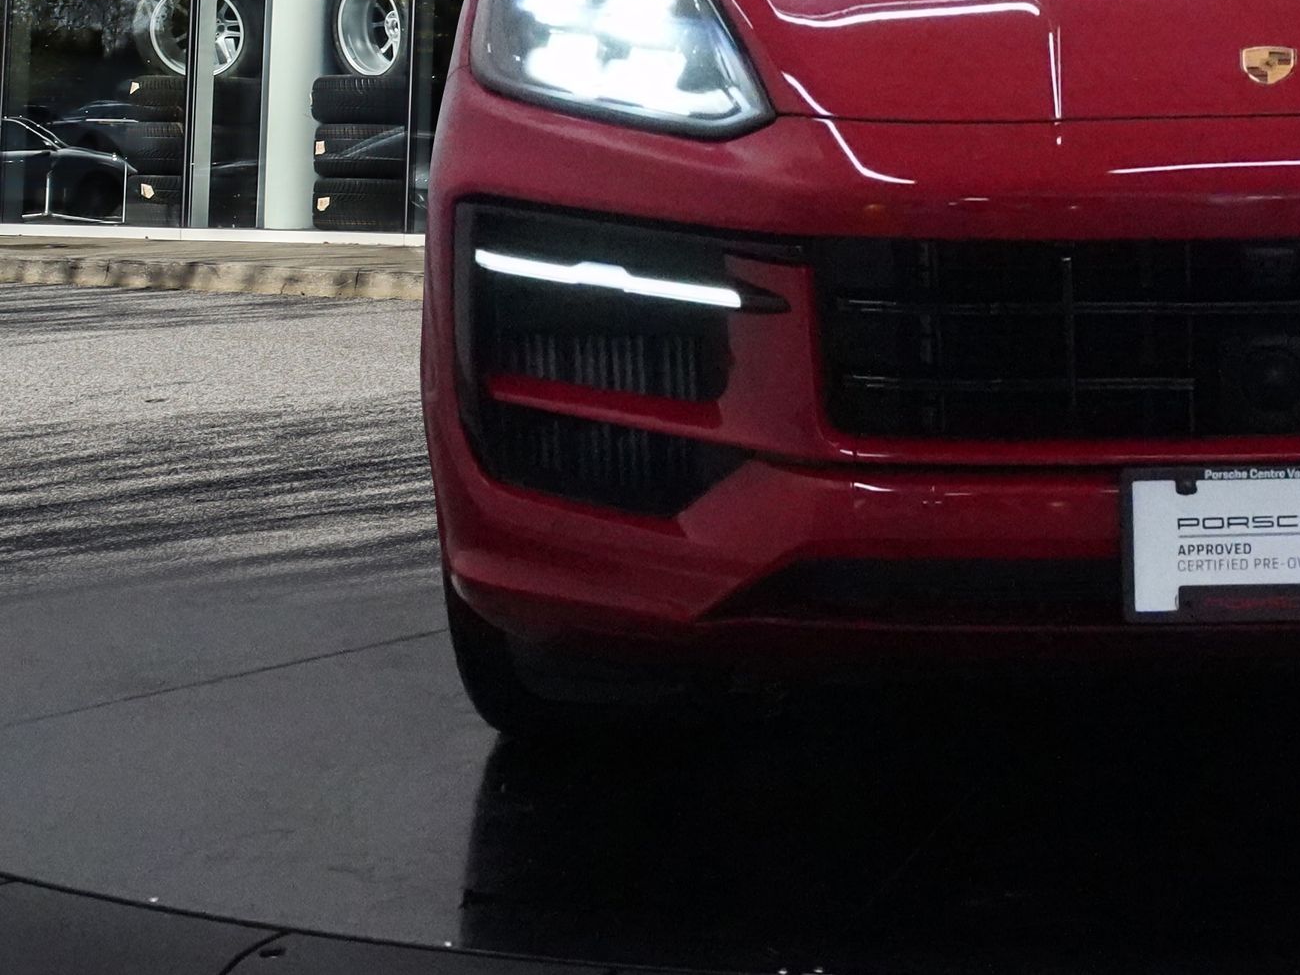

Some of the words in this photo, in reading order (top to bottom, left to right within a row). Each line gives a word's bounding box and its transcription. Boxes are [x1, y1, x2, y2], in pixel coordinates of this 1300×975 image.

[1204, 468, 1247, 480] Porsche
[1249, 468, 1285, 479] Centre
[1178, 543, 1251, 556] APPROVED
[1177, 558, 1249, 571] CERTIFIED
